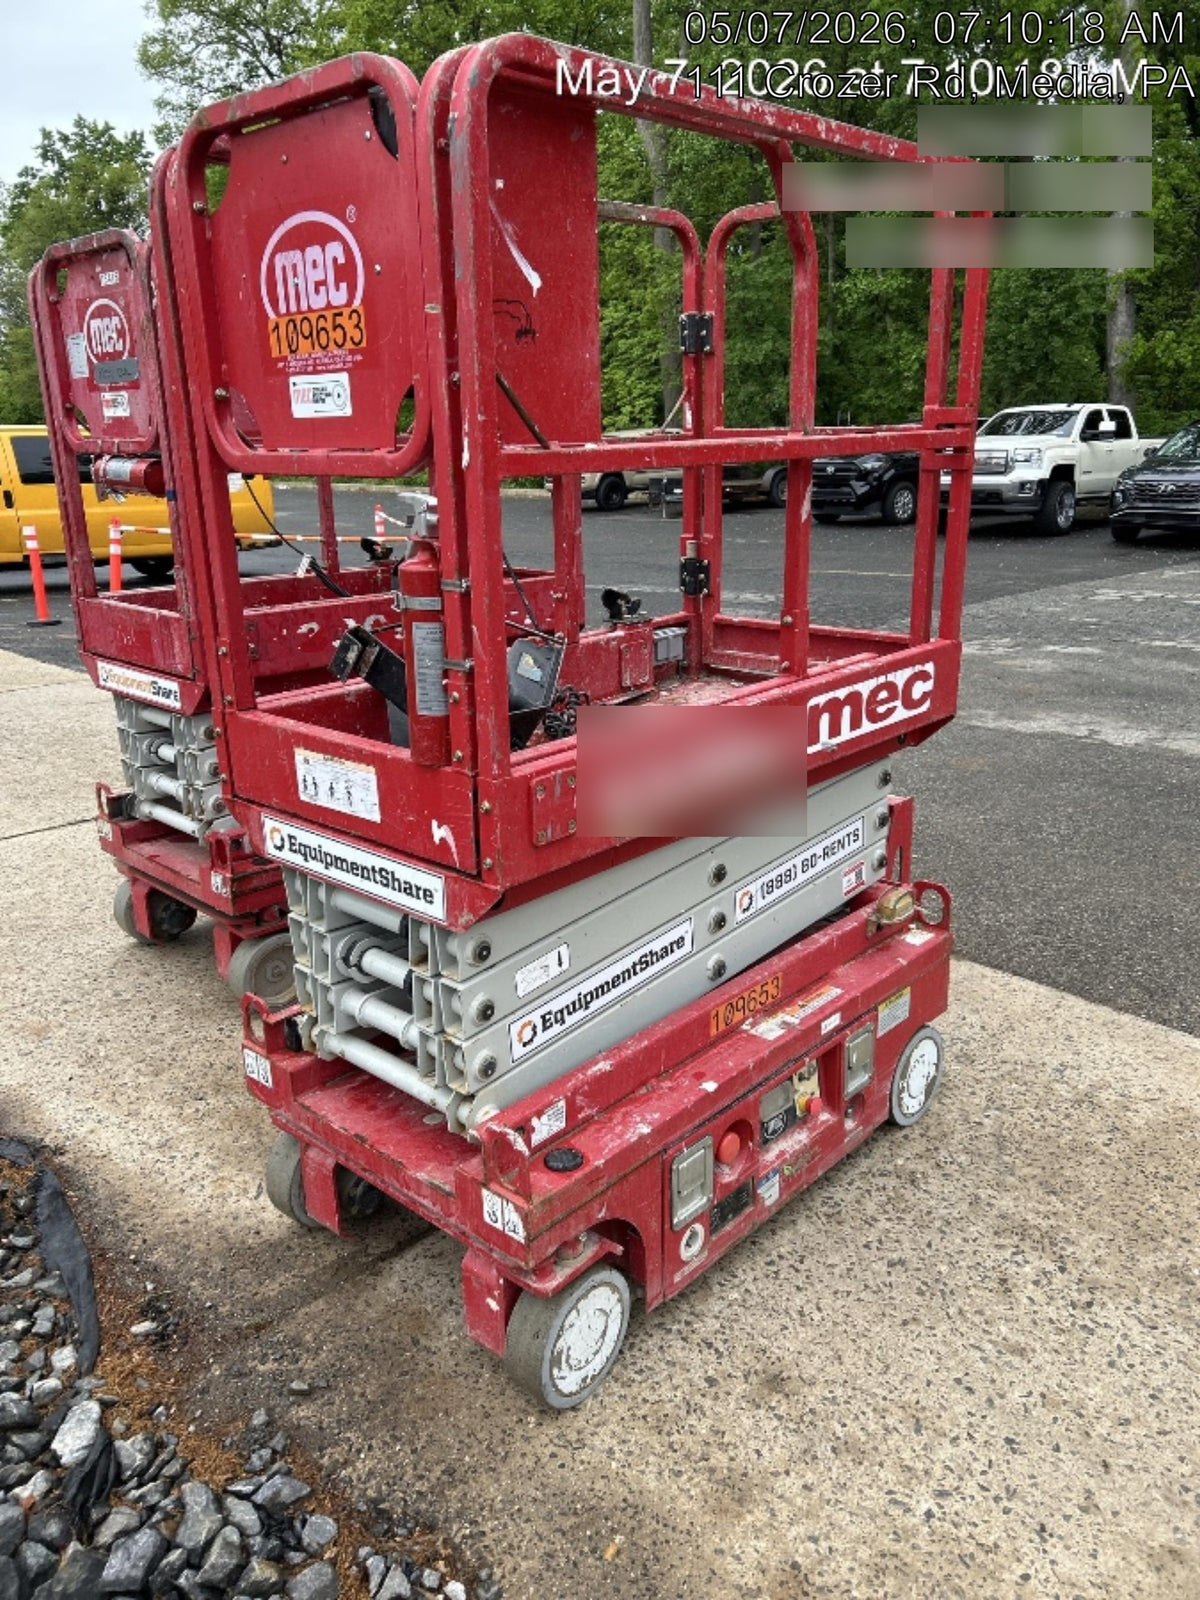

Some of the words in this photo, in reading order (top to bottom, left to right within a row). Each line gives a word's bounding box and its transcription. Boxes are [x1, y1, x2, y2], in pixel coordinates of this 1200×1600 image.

[270, 308, 365, 355] 109653
[287, 832, 436, 905] EquipmentShare
[539, 933, 687, 1034] EquipmentShare
[711, 976, 781, 1033] 109653
